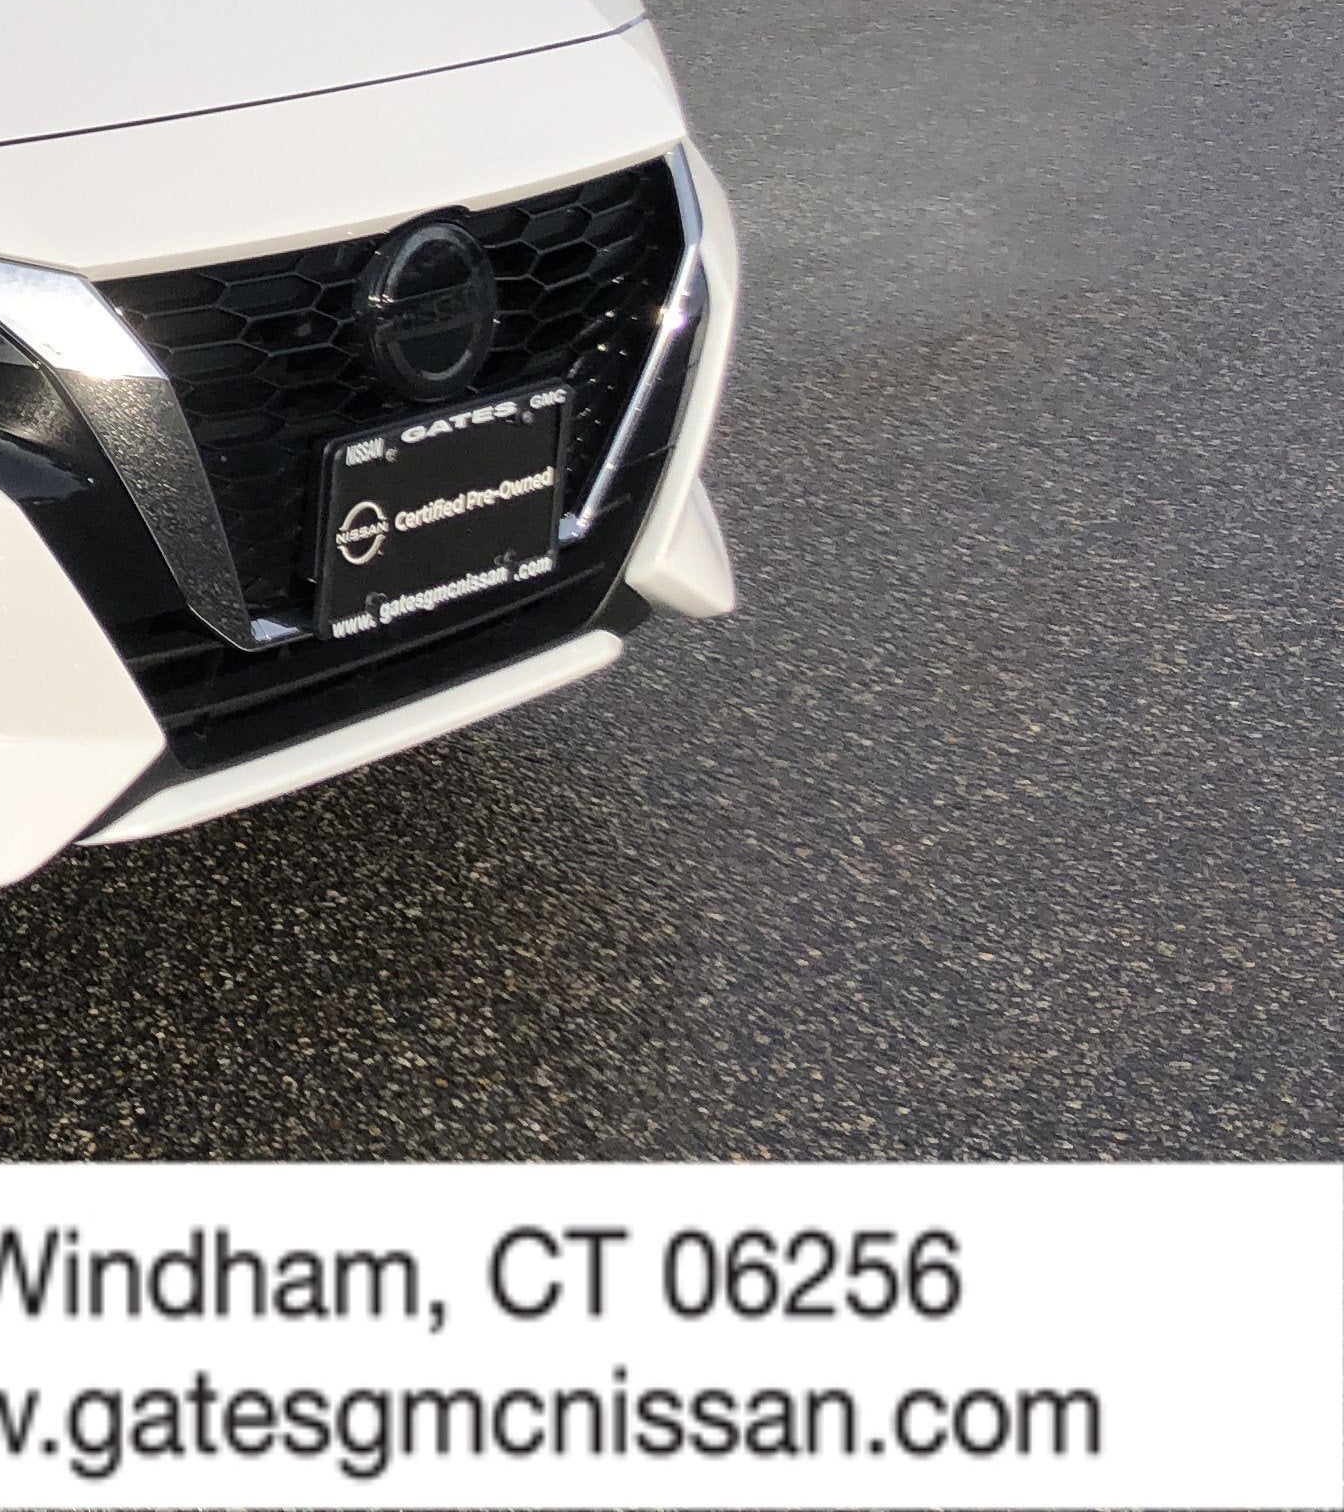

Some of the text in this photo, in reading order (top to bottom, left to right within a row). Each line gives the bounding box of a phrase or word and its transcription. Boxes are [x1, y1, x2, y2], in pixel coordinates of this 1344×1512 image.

[400, 401, 518, 444] GATES
[394, 465, 555, 532] Certified Pre-Owned
[335, 520, 391, 545] NISSAN
